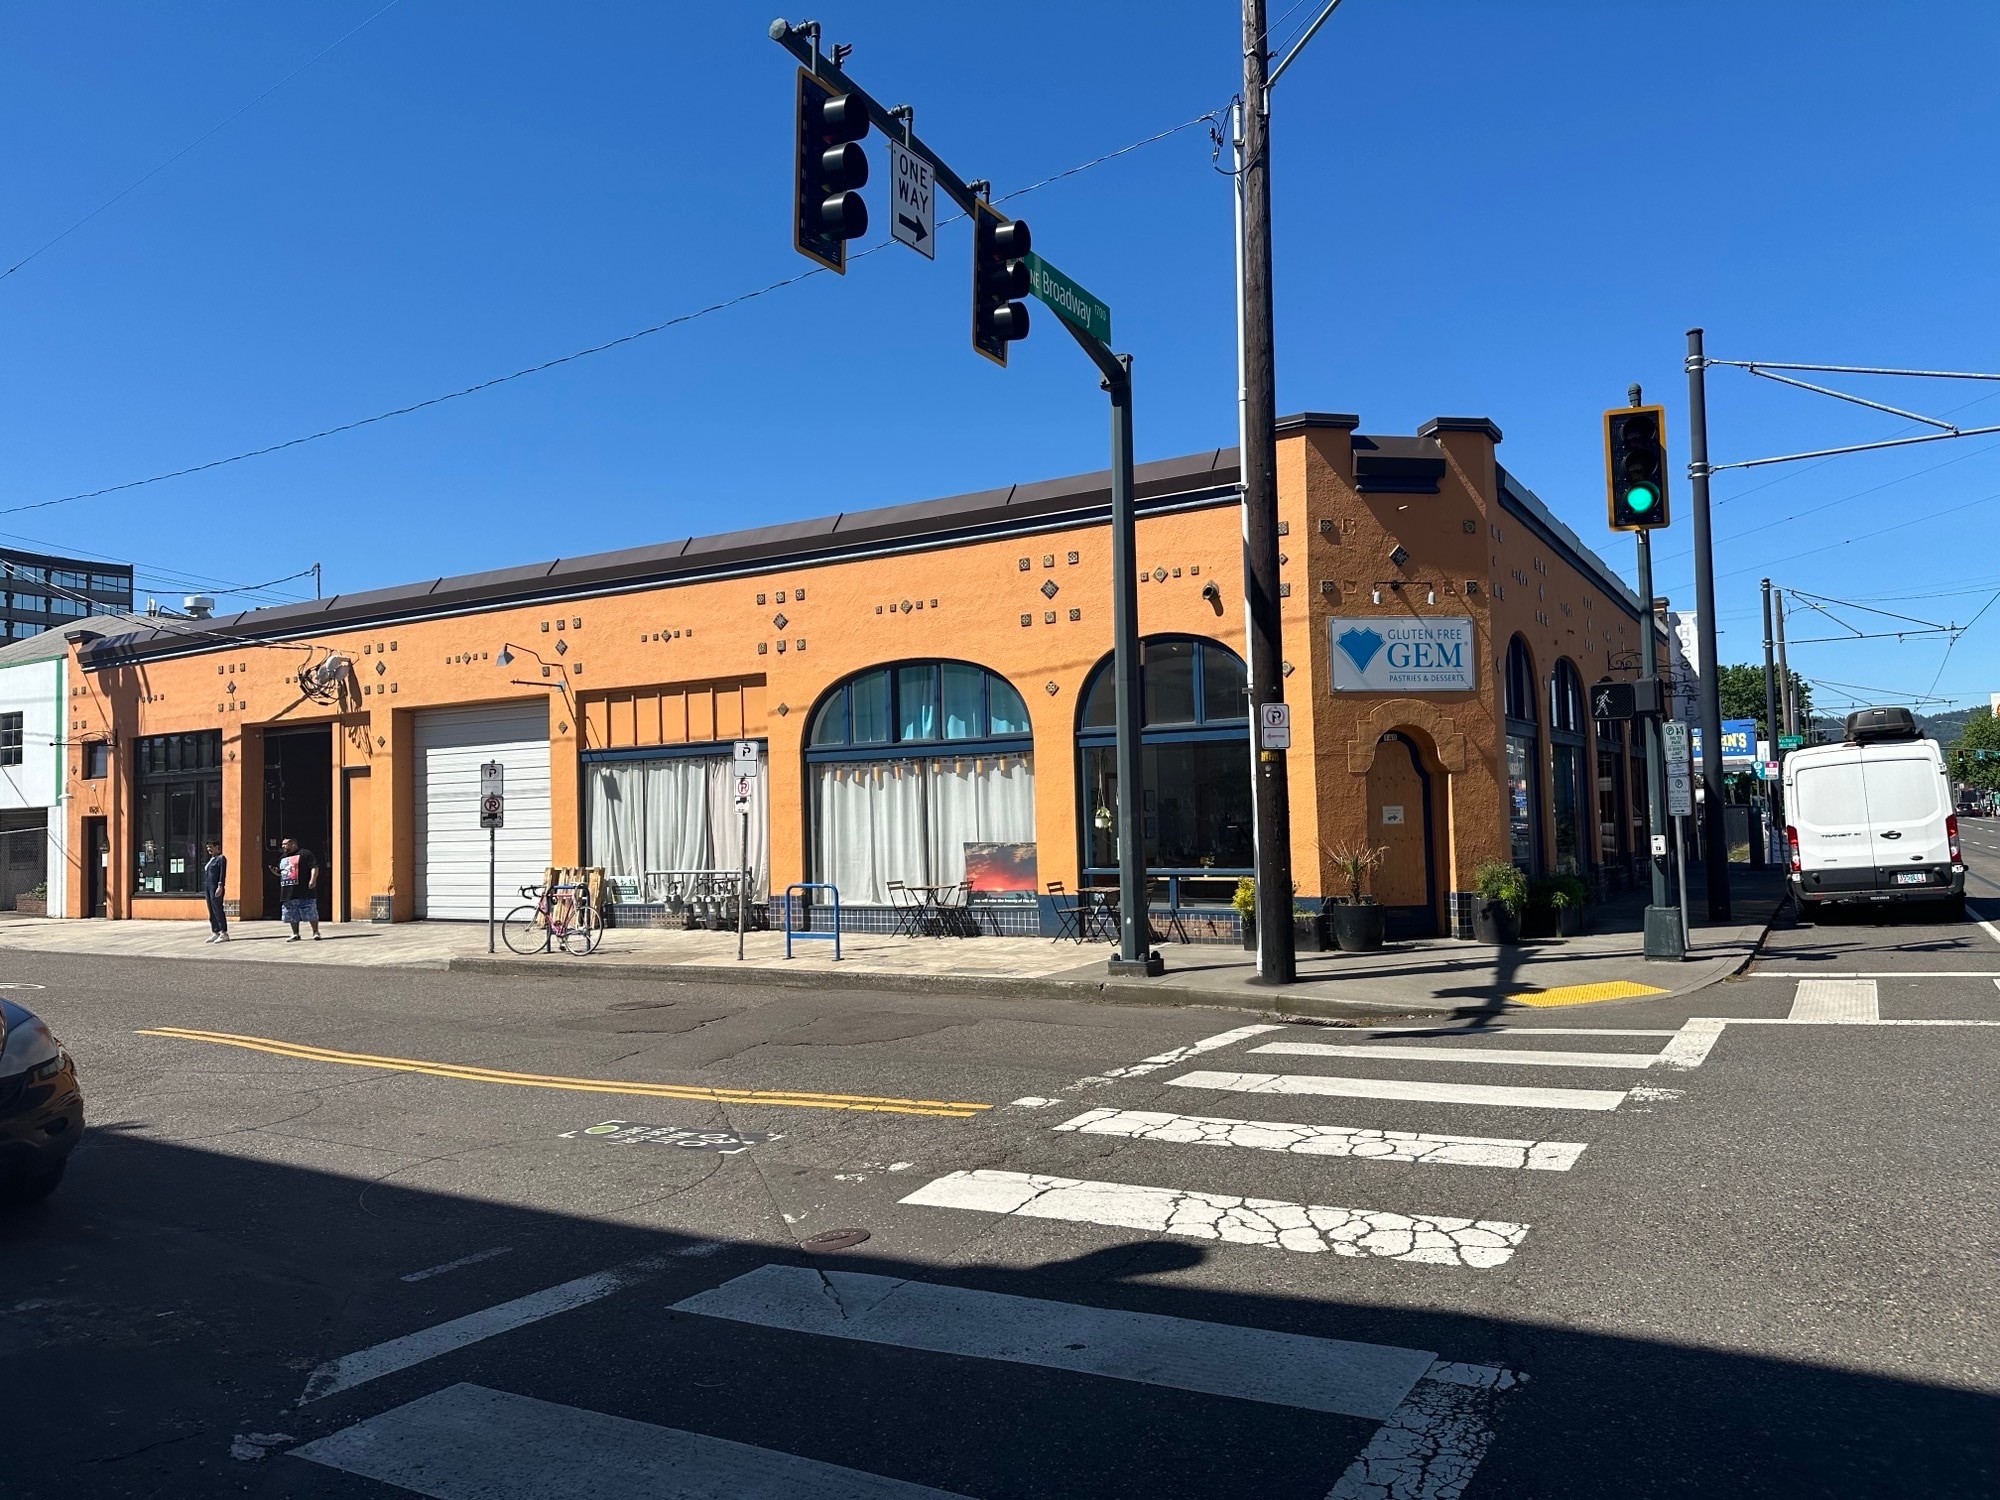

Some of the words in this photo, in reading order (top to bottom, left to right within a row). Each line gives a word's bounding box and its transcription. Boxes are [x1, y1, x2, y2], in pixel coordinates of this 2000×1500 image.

[900, 154, 927, 190] ONE
[899, 177, 928, 214] WAY
[1030, 269, 1040, 289] NE
[1043, 271, 1091, 328] Broadway
[1388, 629, 1433, 640] GLUTEN
[1438, 629, 1462, 640] FREE
[1387, 642, 1464, 668] GEM
[1389, 674, 1421, 682] PASTRIES
[1423, 674, 1429, 682] &
[1431, 674, 1464, 682] DESSERTS
